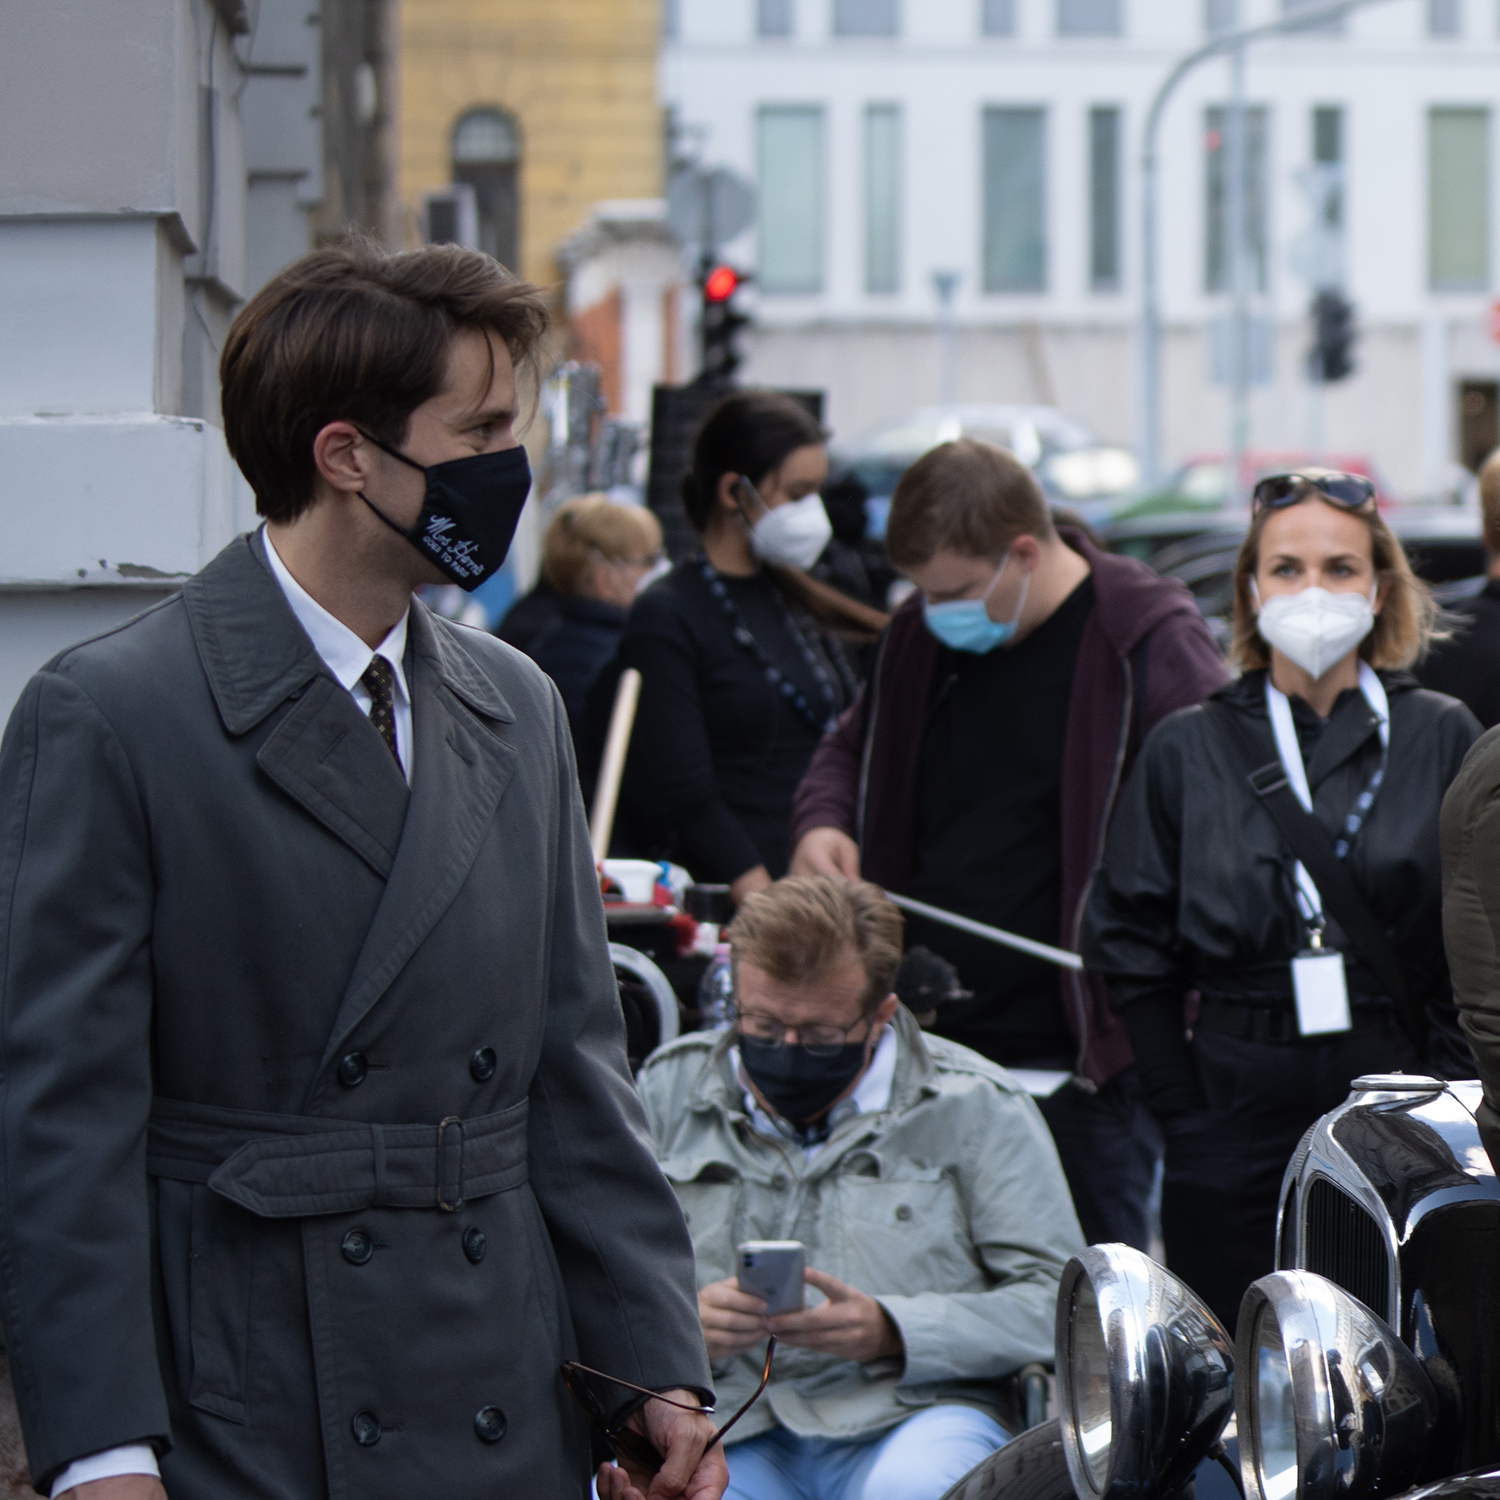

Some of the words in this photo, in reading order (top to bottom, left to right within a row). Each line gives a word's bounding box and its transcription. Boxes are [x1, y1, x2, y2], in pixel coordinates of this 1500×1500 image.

[423, 536, 442, 553] GOES
[441, 551, 453, 564] TO
[450, 560, 470, 577] PARIS
[426, 515, 457, 546] Mrs
[449, 540, 485, 576] Harris
